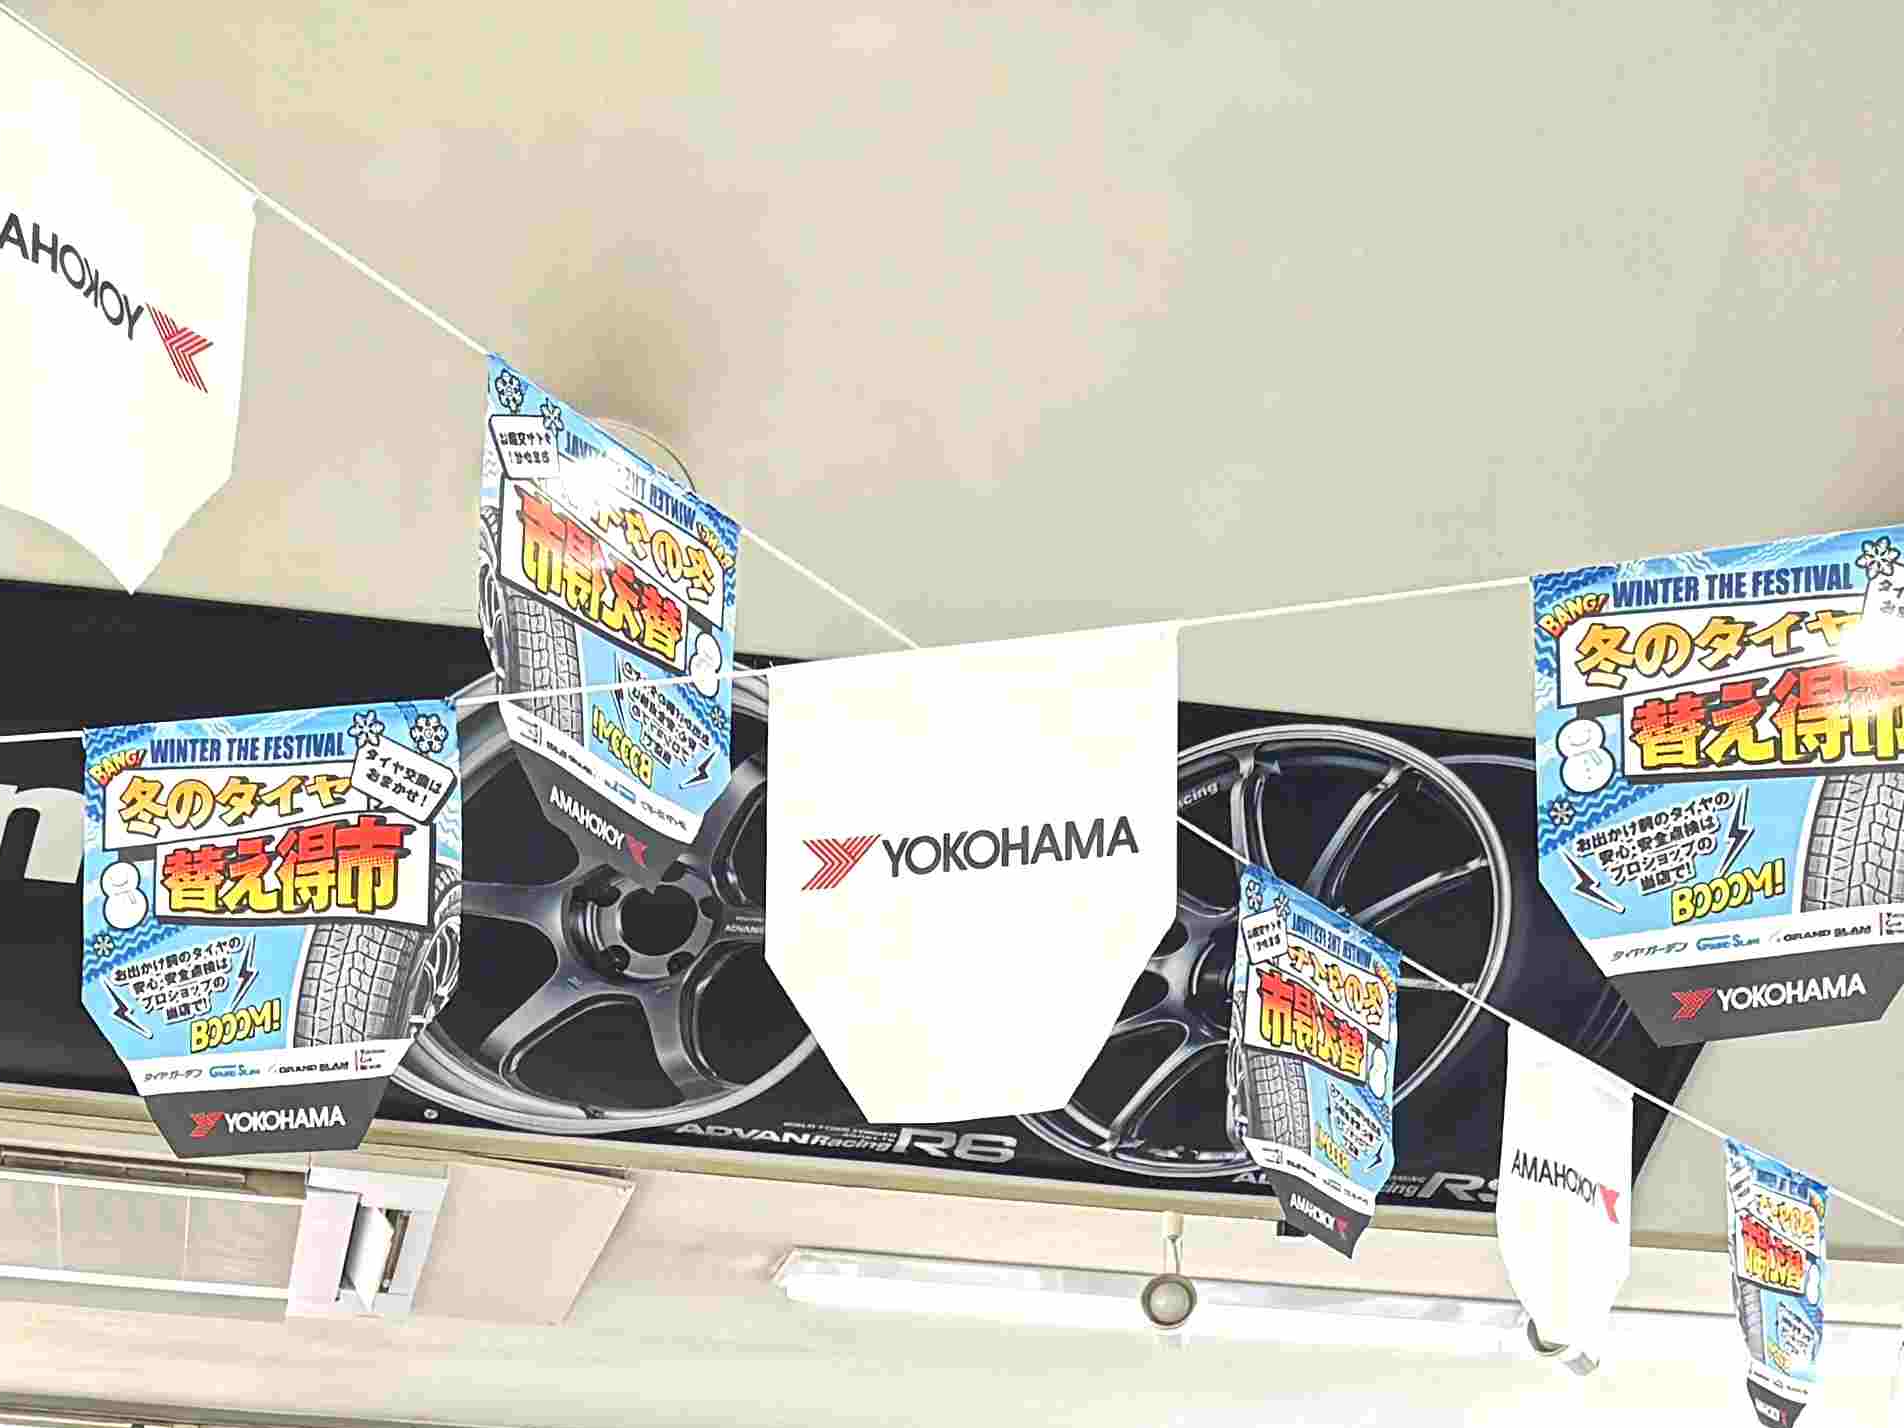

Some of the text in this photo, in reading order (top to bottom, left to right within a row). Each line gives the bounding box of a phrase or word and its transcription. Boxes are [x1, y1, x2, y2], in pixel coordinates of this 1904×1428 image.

[1612, 562, 1854, 609] WINTER THE FESTIVAL
[1538, 593, 1610, 636] BANG!
[1575, 607, 1864, 690] 冬のタイヤ
[88, 748, 147, 786] BANG!
[150, 731, 345, 765] WINTER THE FESTIVAL
[118, 774, 352, 838] 冬のタイヤ
[162, 816, 406, 915] 替え得市
[882, 815, 1140, 878] YOKOHAMA
[1671, 859, 1786, 925] BOOOM!
[1716, 972, 1867, 1013] YOKOHAMA
[190, 999, 282, 1054] BOOOM!
[224, 1105, 346, 1133] YOKOHAMA
[676, 1122, 812, 1146] ADVAN
[809, 1130, 897, 1154] Racing
[894, 1128, 1017, 1164] R6
